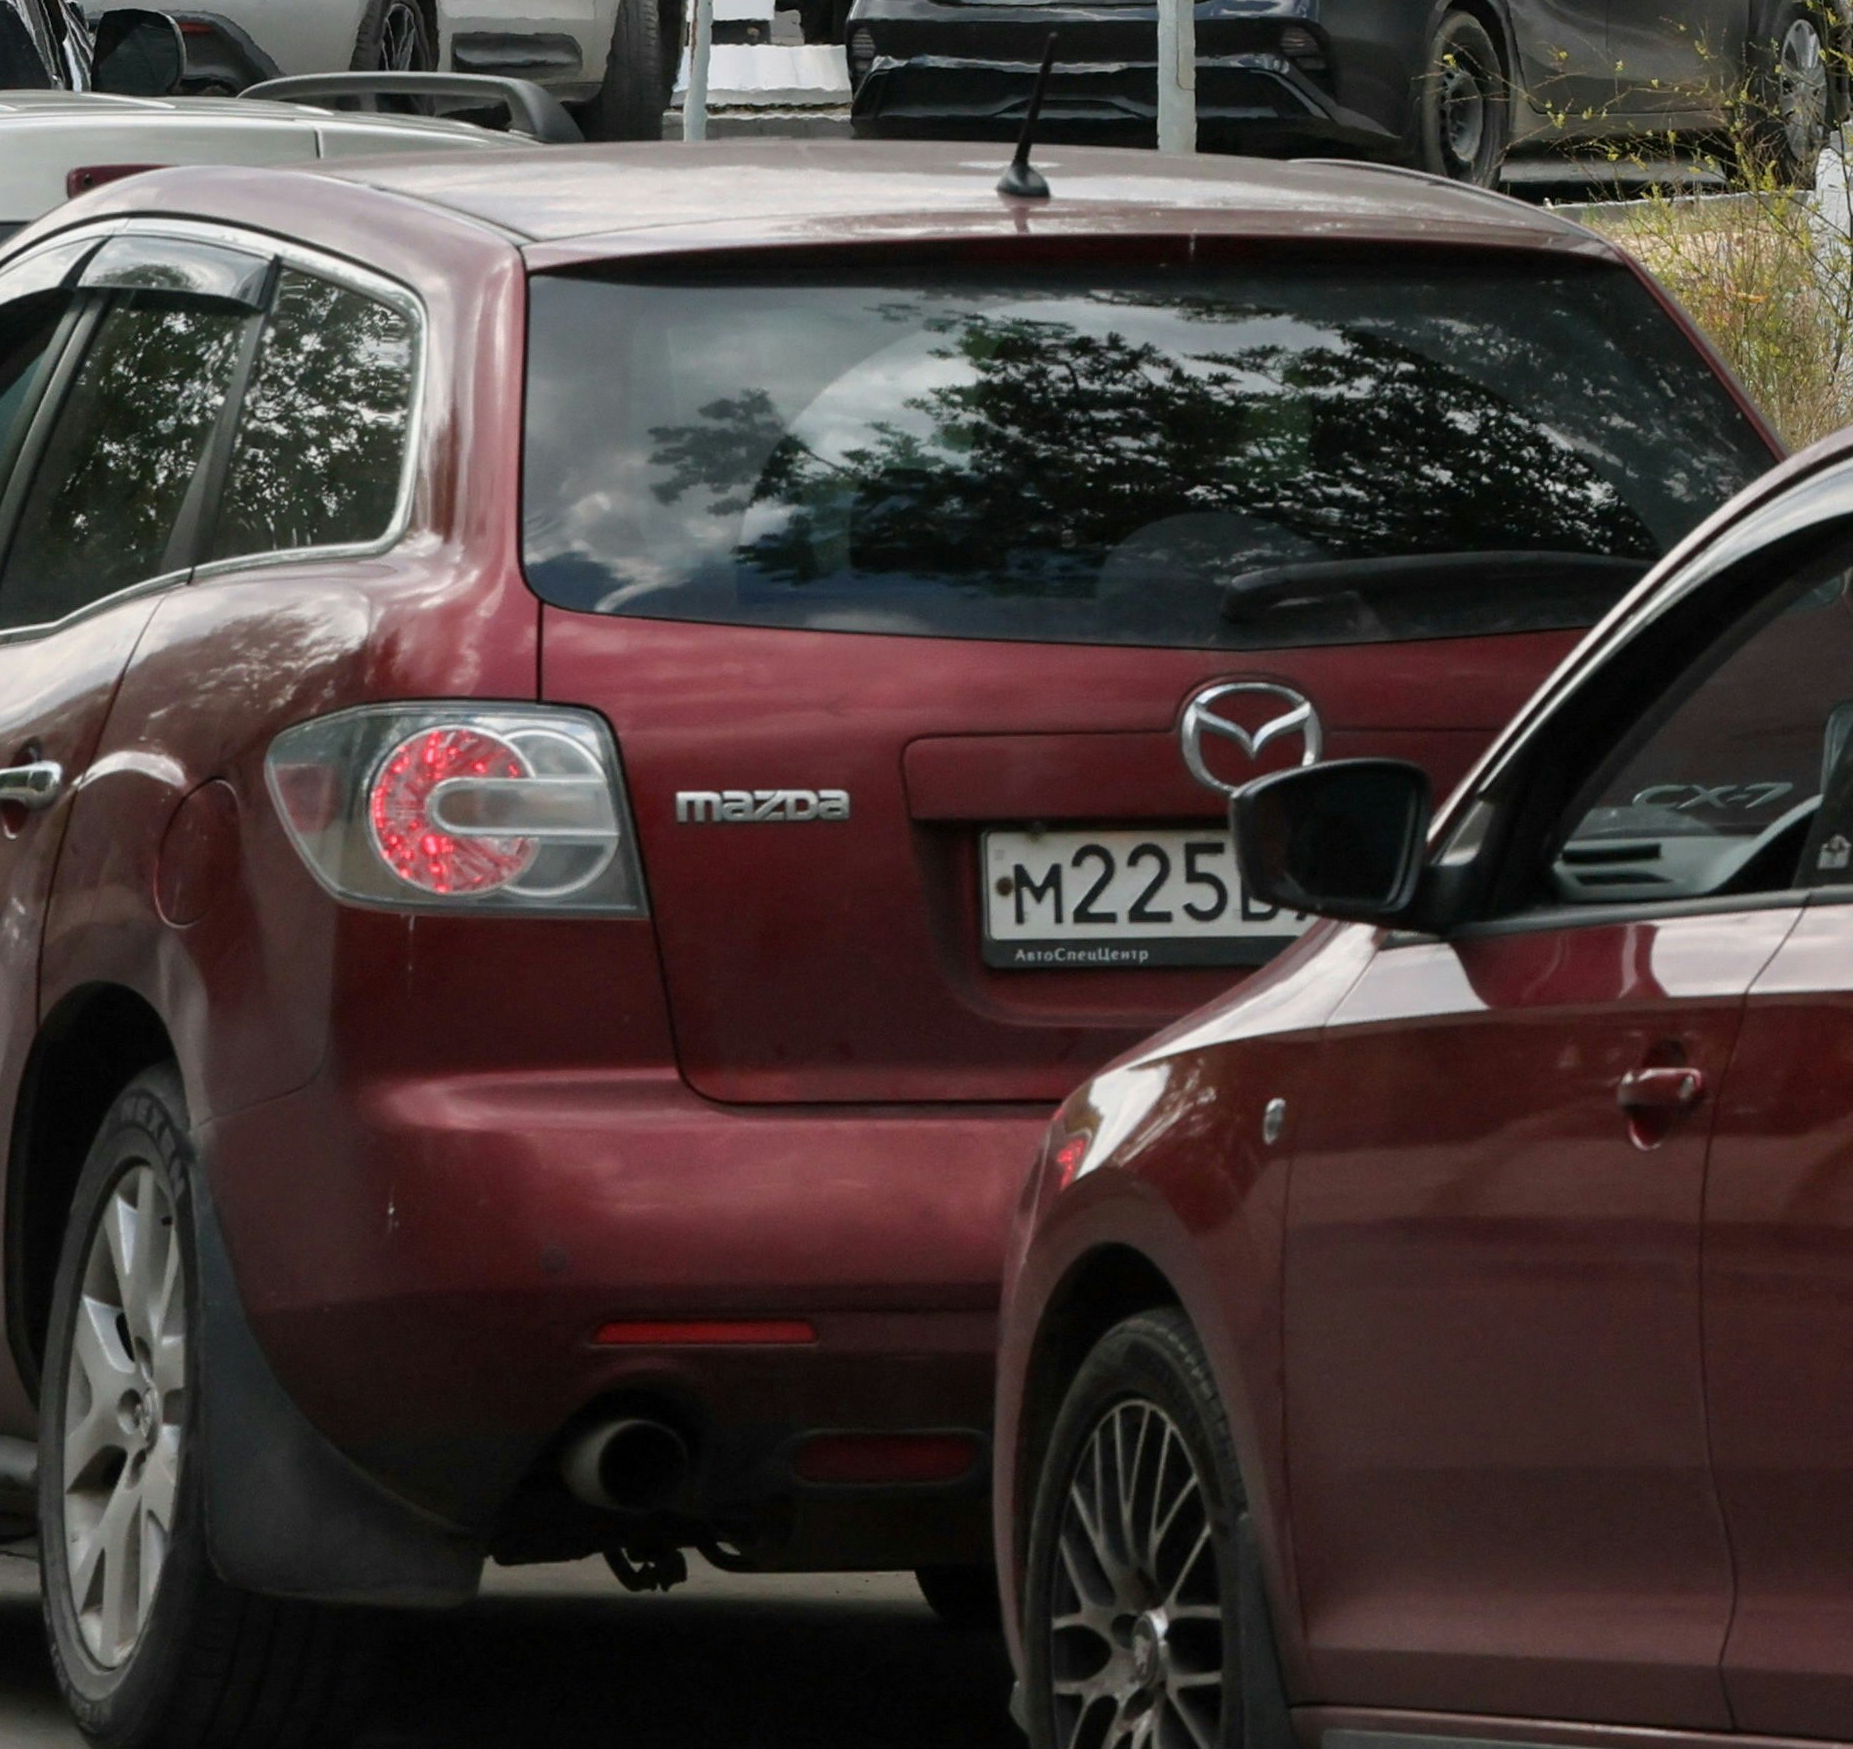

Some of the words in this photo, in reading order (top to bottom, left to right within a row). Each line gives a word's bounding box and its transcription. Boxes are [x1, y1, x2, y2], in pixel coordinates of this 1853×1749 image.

[1632, 782, 1793, 810] CX-7
[1013, 842, 1307, 926] М225
[1014, 947, 1150, 965] АвтоСпецЦентр
